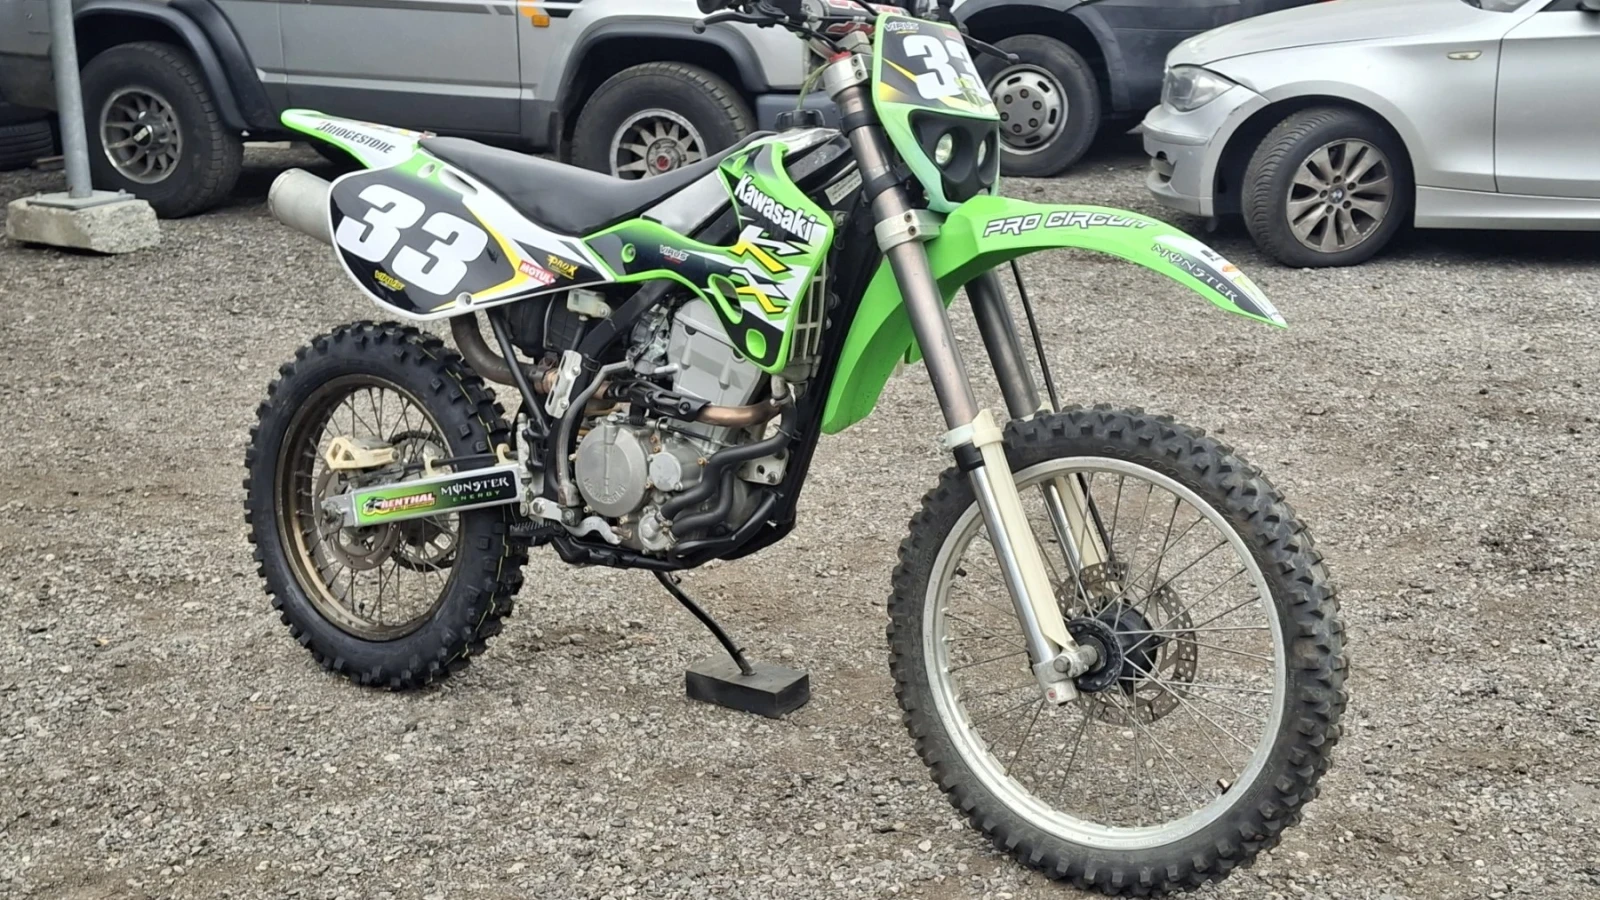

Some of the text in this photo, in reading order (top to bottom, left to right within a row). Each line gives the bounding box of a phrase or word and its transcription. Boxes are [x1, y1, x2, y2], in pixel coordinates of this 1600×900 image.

[315, 121, 396, 154] BRIDGESTONE
[734, 172, 817, 242] Kawasaki
[983, 204, 1157, 238] PRO CIRCUIT
[336, 184, 489, 295] 33
[520, 262, 552, 284] MOTUL
[1151, 243, 1239, 304] MONSTER
[441, 477, 510, 496] MONSTER
[452, 490, 501, 502] ENERGY
